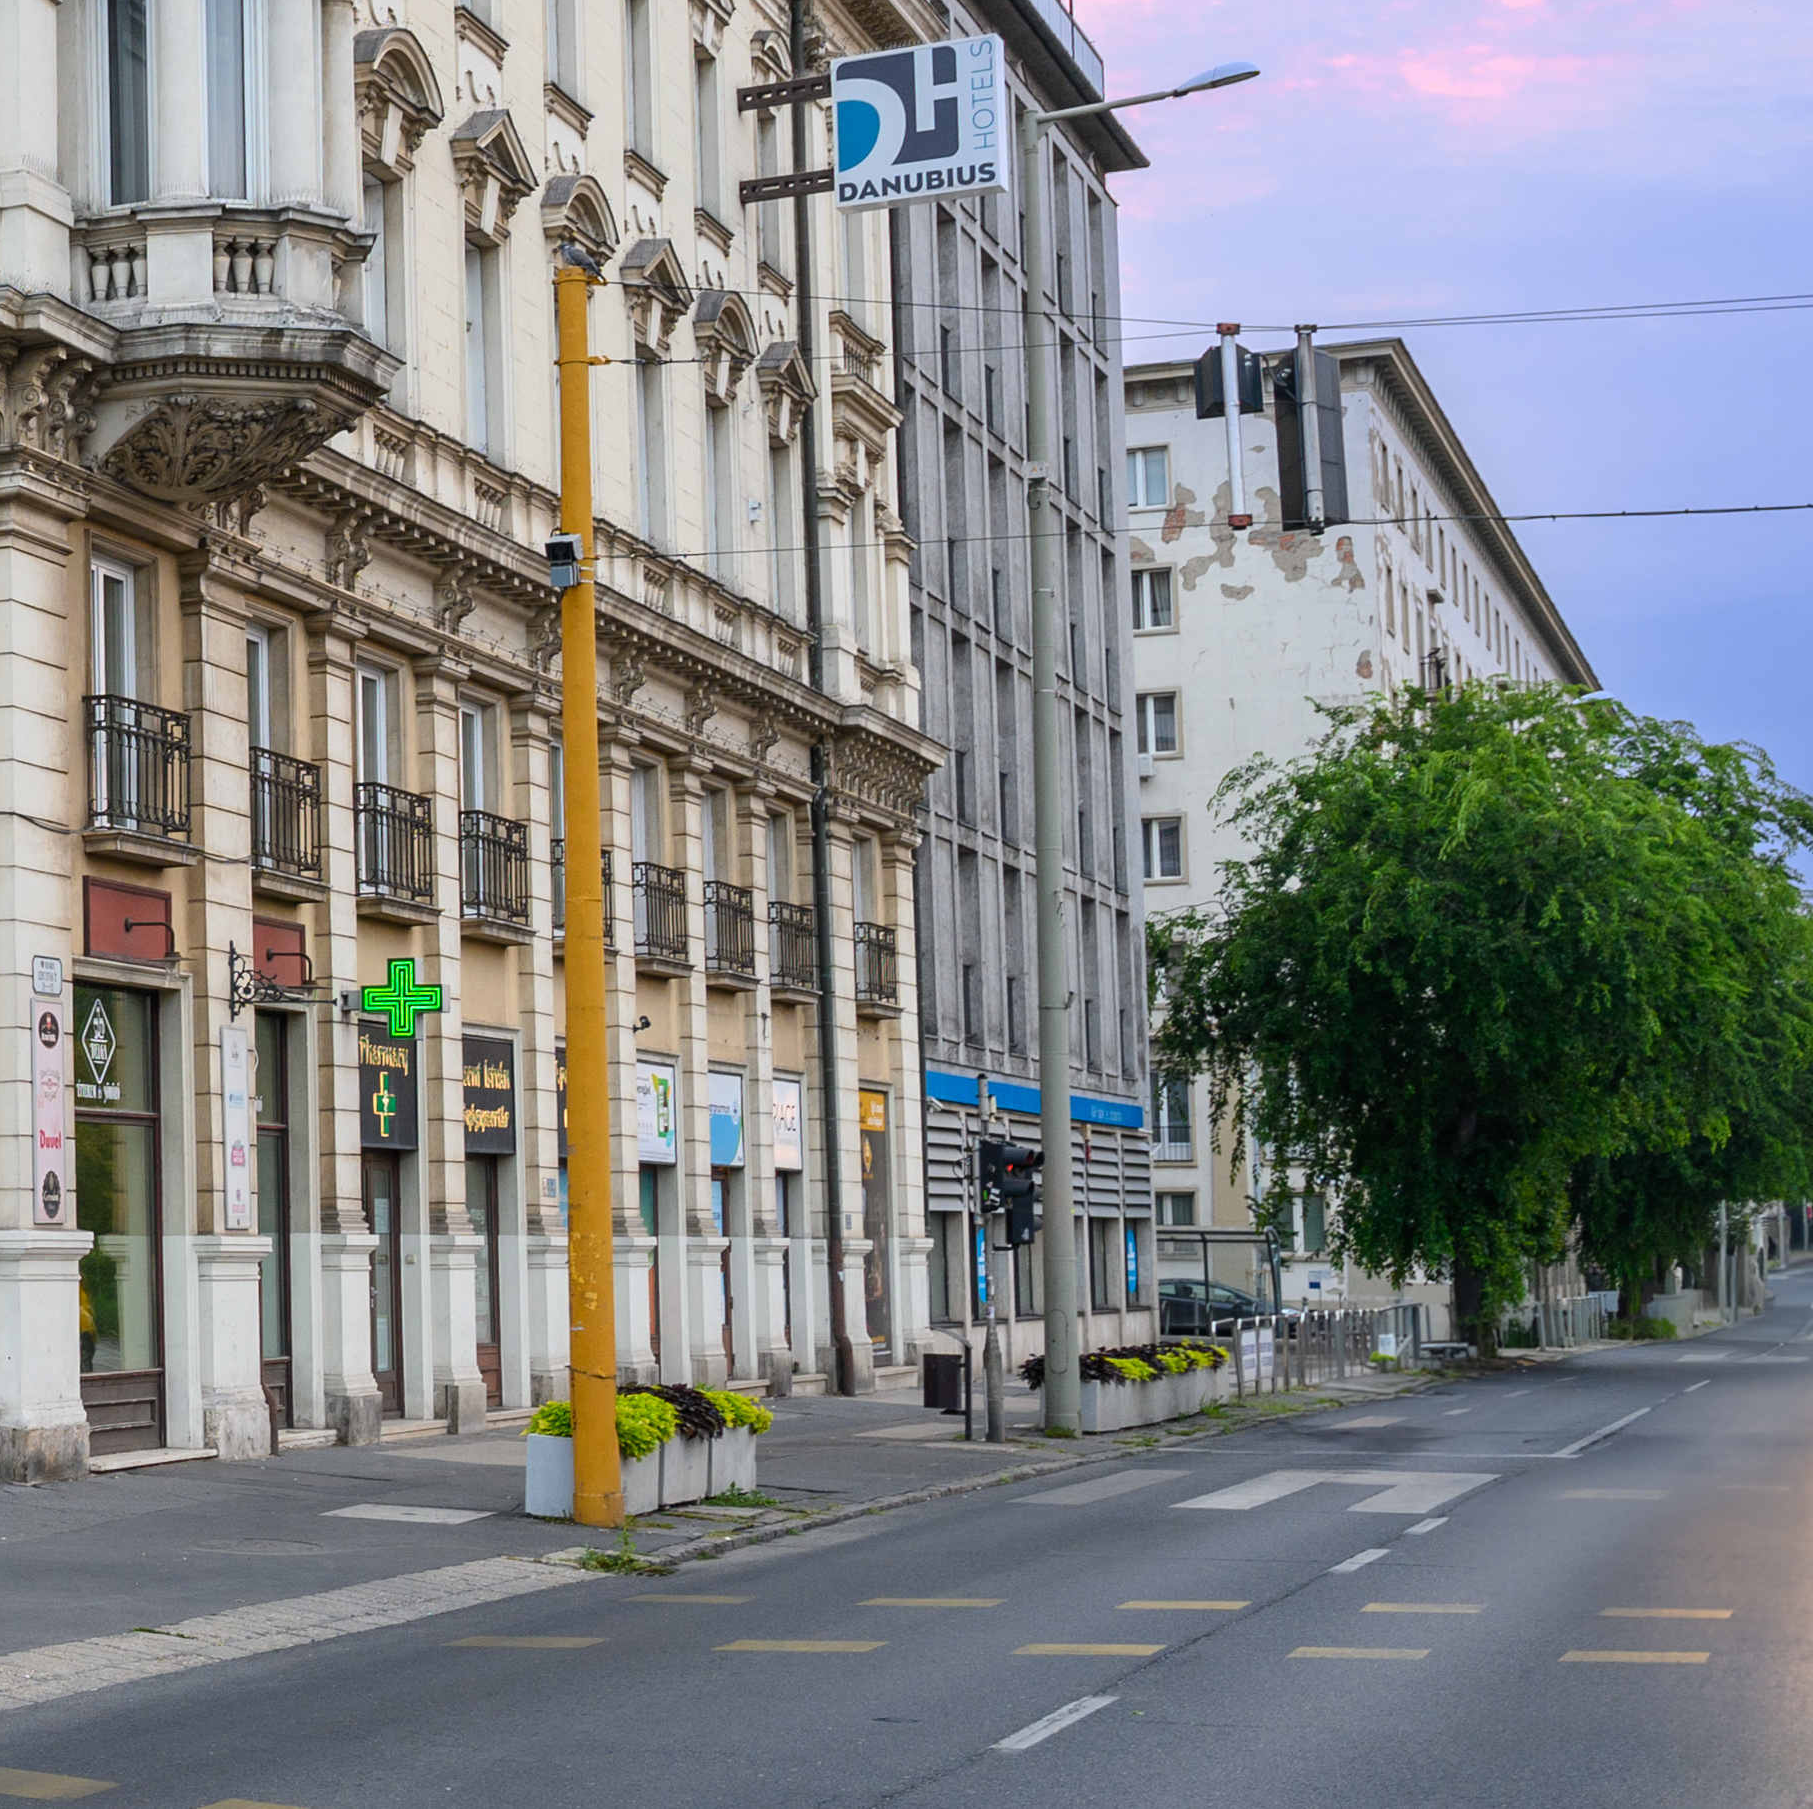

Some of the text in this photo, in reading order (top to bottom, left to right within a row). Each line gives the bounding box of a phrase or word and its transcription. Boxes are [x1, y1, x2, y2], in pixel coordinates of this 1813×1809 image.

[970, 40, 995, 150] HOTELS
[839, 162, 996, 203] DANUBIUS
[39, 1128, 62, 1149] Duvel
